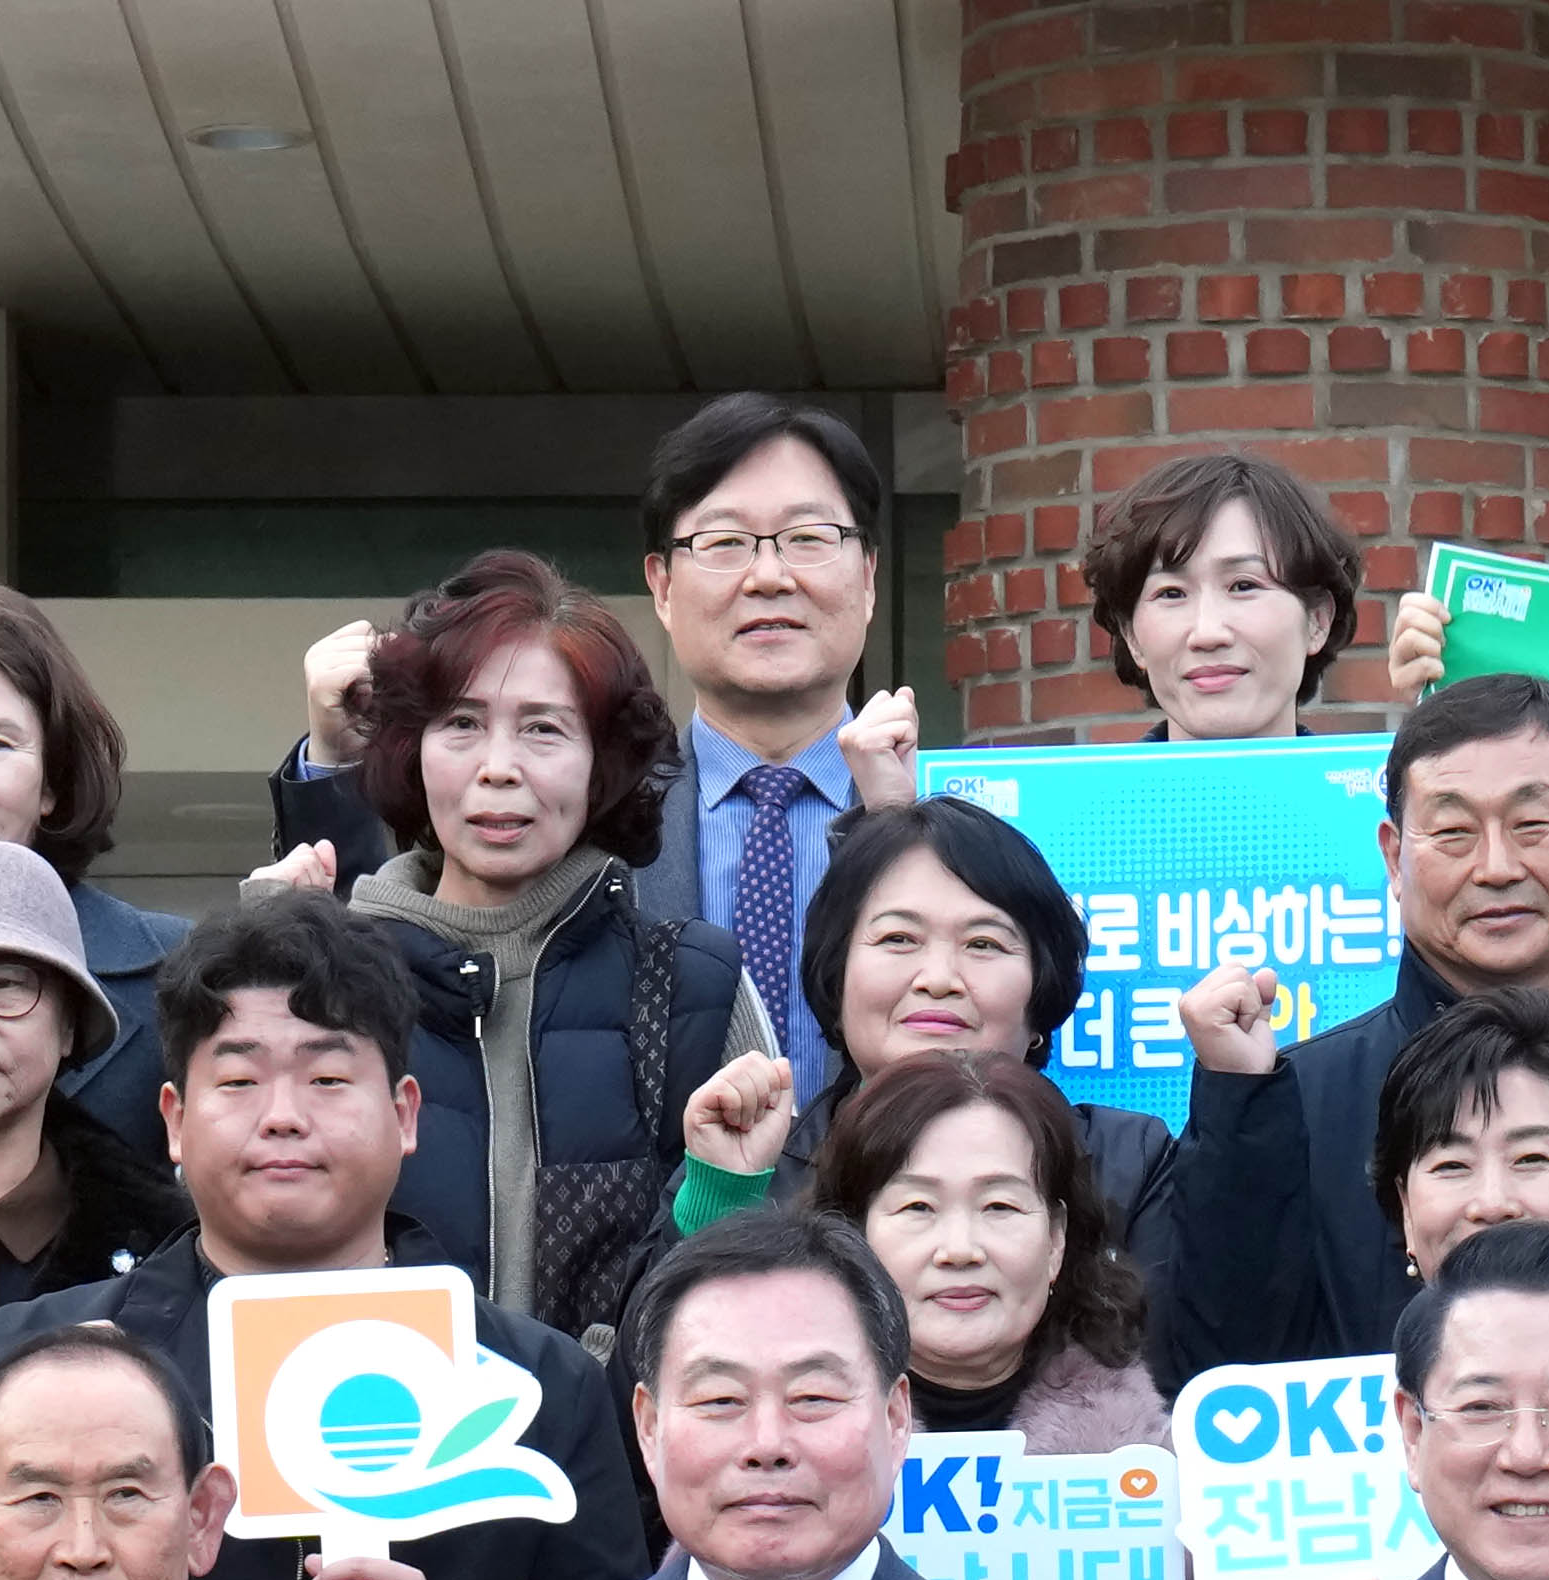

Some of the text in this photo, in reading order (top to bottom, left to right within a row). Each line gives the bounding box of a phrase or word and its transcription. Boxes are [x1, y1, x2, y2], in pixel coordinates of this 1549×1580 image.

[1077, 891, 1142, 972] 로
[1194, 1374, 1387, 1463] OK!
[879, 1456, 1003, 1534] K!
[1012, 1469, 1164, 1529] 지금은
